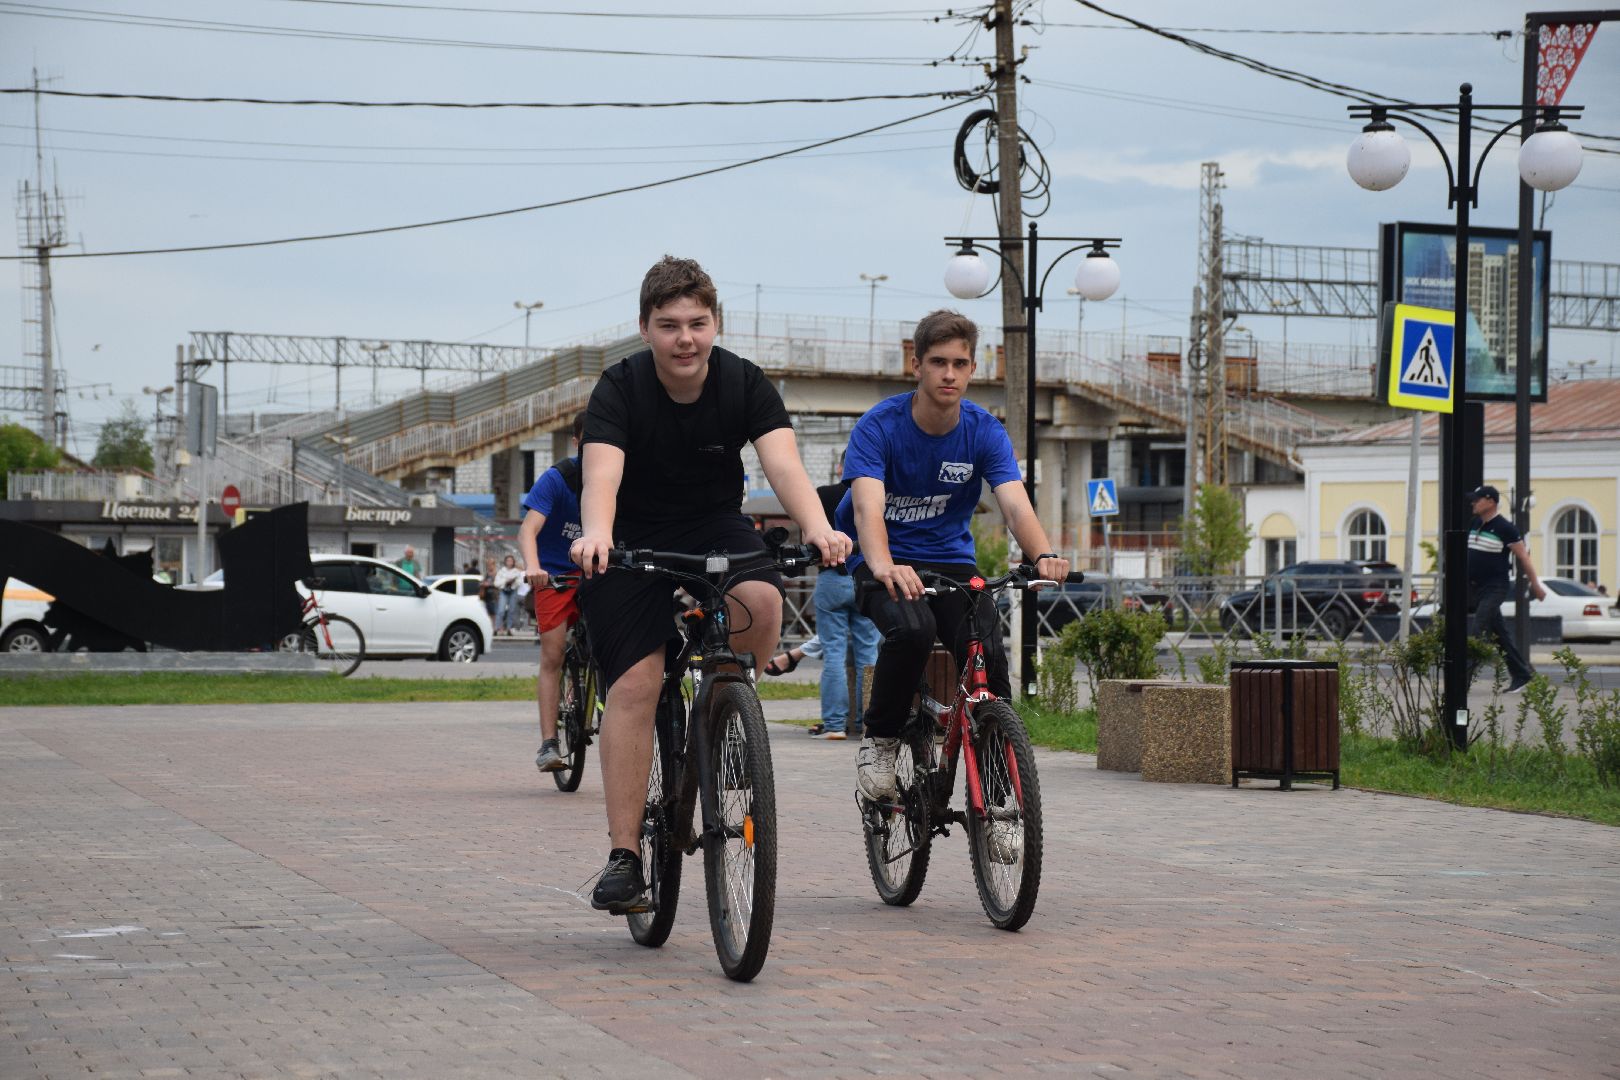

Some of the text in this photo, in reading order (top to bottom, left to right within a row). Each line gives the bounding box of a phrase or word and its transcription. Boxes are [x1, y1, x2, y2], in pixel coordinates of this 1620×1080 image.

[102, 500, 171, 521] Цветы
[345, 506, 412, 526] Бистро
[884, 497, 952, 523] АРДИЯ
